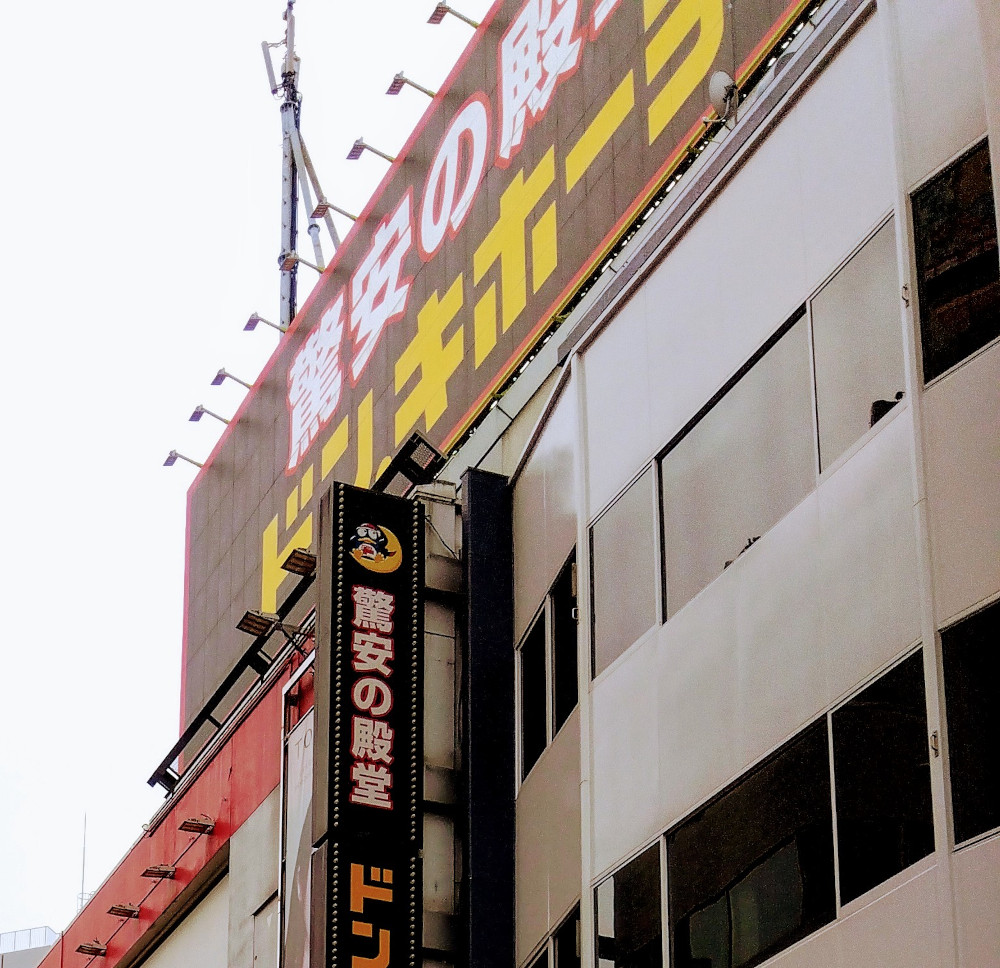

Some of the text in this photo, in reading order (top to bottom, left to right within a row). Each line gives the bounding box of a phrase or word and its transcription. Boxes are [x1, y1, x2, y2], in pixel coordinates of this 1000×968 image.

[286, 0, 619, 472] 驚安の殿
[349, 584, 395, 811] 驚安の殿堂
